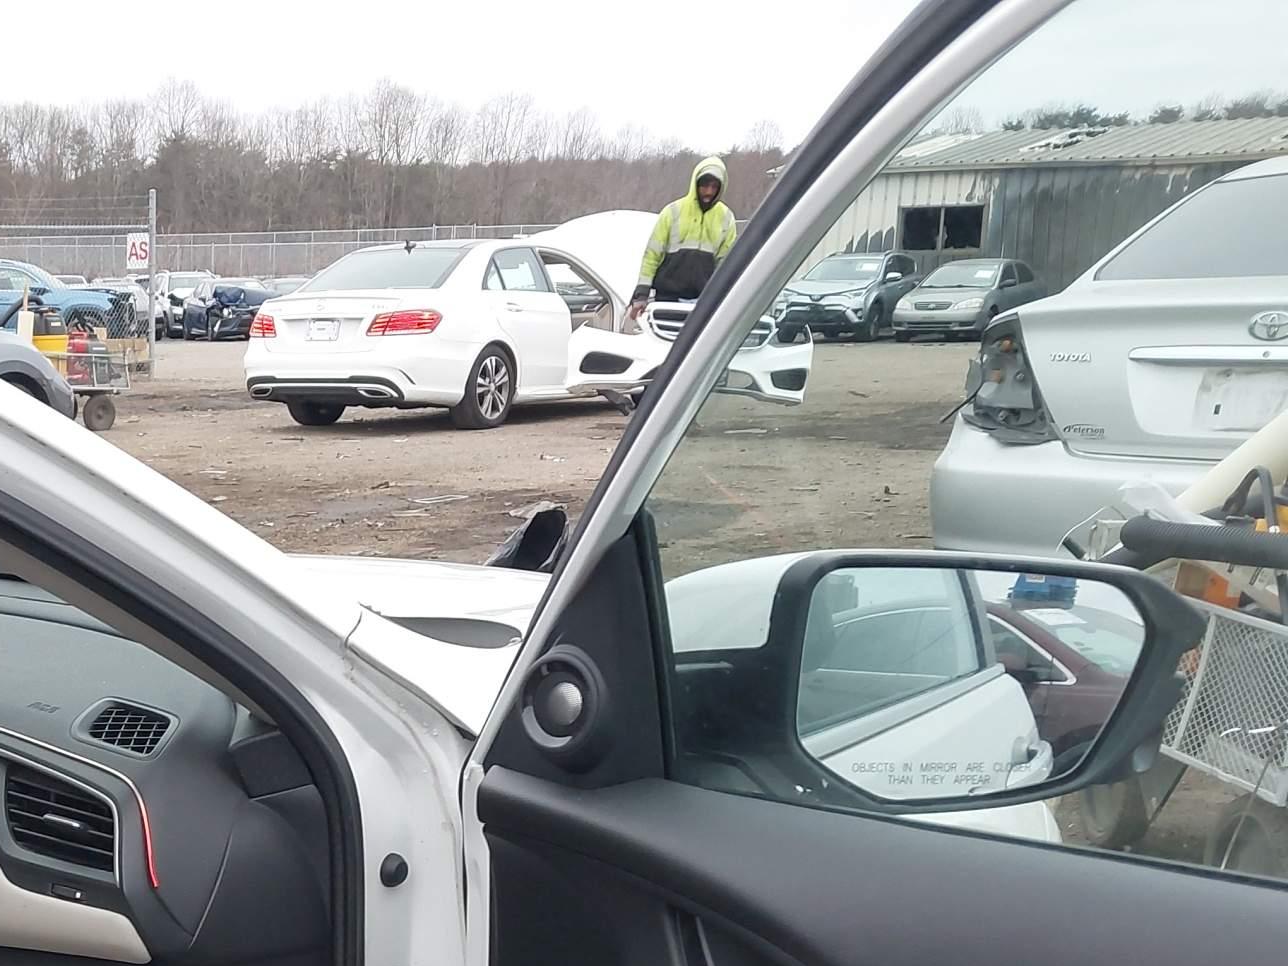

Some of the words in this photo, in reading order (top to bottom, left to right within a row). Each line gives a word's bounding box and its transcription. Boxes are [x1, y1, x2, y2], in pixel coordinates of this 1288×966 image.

[128, 241, 148, 260] AS
[1049, 352, 1092, 362] TOYOTA
[851, 763, 895, 773] OBJECTS
[902, 763, 912, 772] IN
[920, 763, 957, 772] MIRROR
[966, 762, 985, 772] ARE
[888, 775, 912, 784] THAN
[921, 775, 944, 784] THEY
[953, 775, 991, 784] APPEAR
